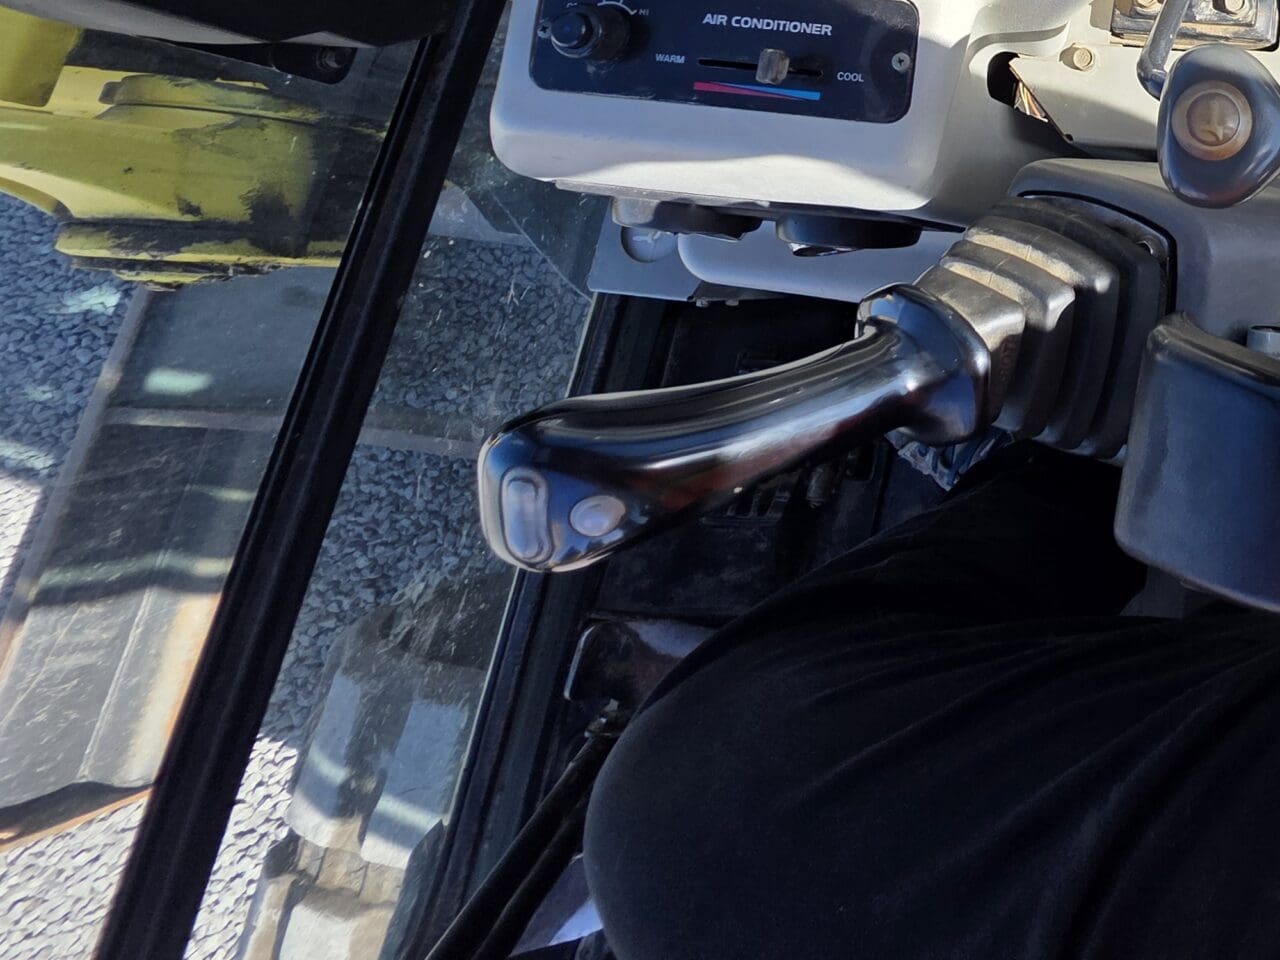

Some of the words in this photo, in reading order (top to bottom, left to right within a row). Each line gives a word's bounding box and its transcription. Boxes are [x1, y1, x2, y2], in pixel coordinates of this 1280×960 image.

[638, 8, 649, 16] HI
[702, 13, 727, 27] AIR
[731, 16, 832, 36] CONDITIONER
[655, 52, 685, 65] WARM
[836, 71, 865, 83] COOL
